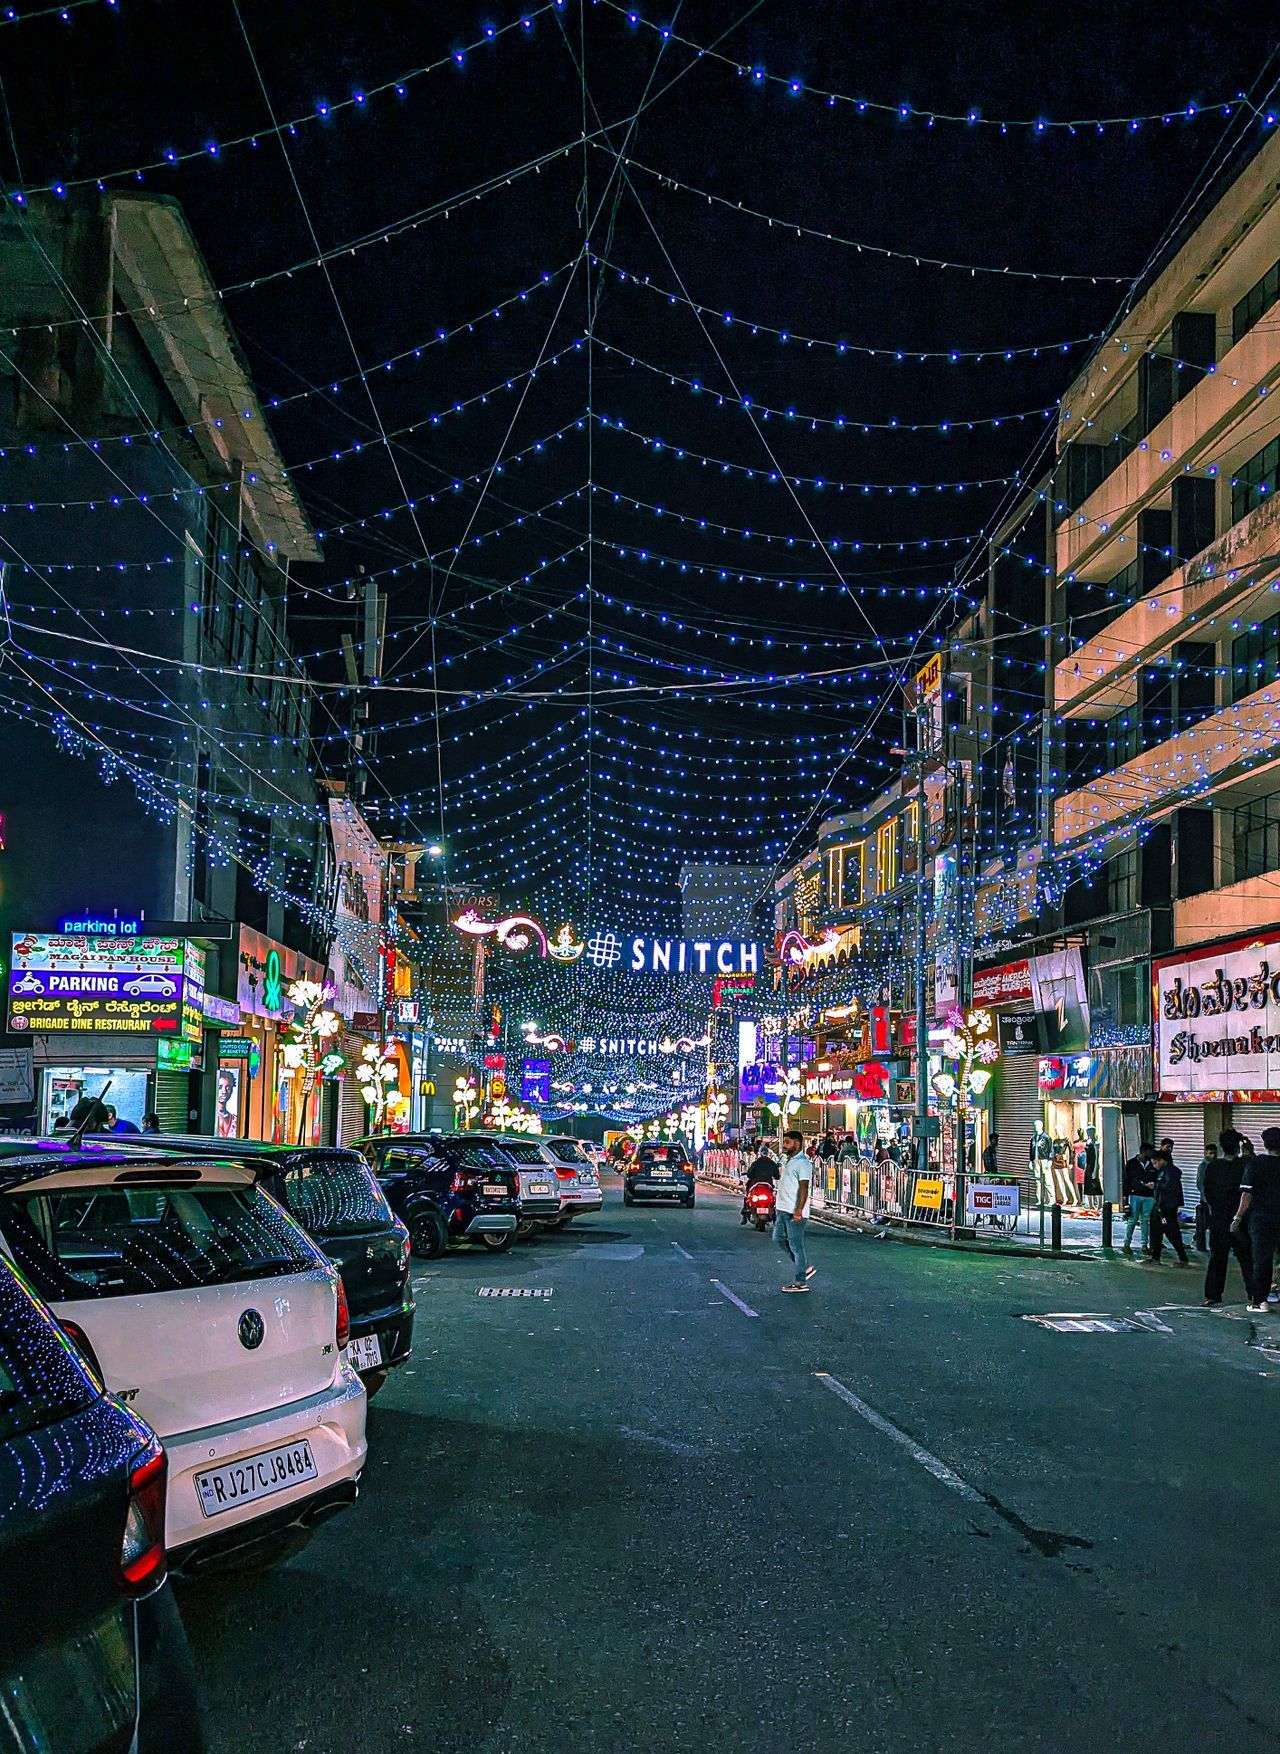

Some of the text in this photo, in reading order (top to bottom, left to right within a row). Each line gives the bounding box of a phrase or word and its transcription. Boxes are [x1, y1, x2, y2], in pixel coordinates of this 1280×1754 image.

[64, 920, 137, 935] parking lot
[49, 953, 176, 963] MAGAI PAN HOUSE
[631, 938, 758, 973] SNITCH
[49, 976, 118, 992] PARKING
[66, 999, 99, 1017] ಡೈನ್
[29, 1018, 152, 1031] BRIGADE DINE RESTAURANT
[600, 1038, 657, 1054] SNITCH
[0, 1128, 32, 1136] ING
[975, 1195, 992, 1204] TIGC
[214, 1447, 313, 1503] RJ27CJ8484
